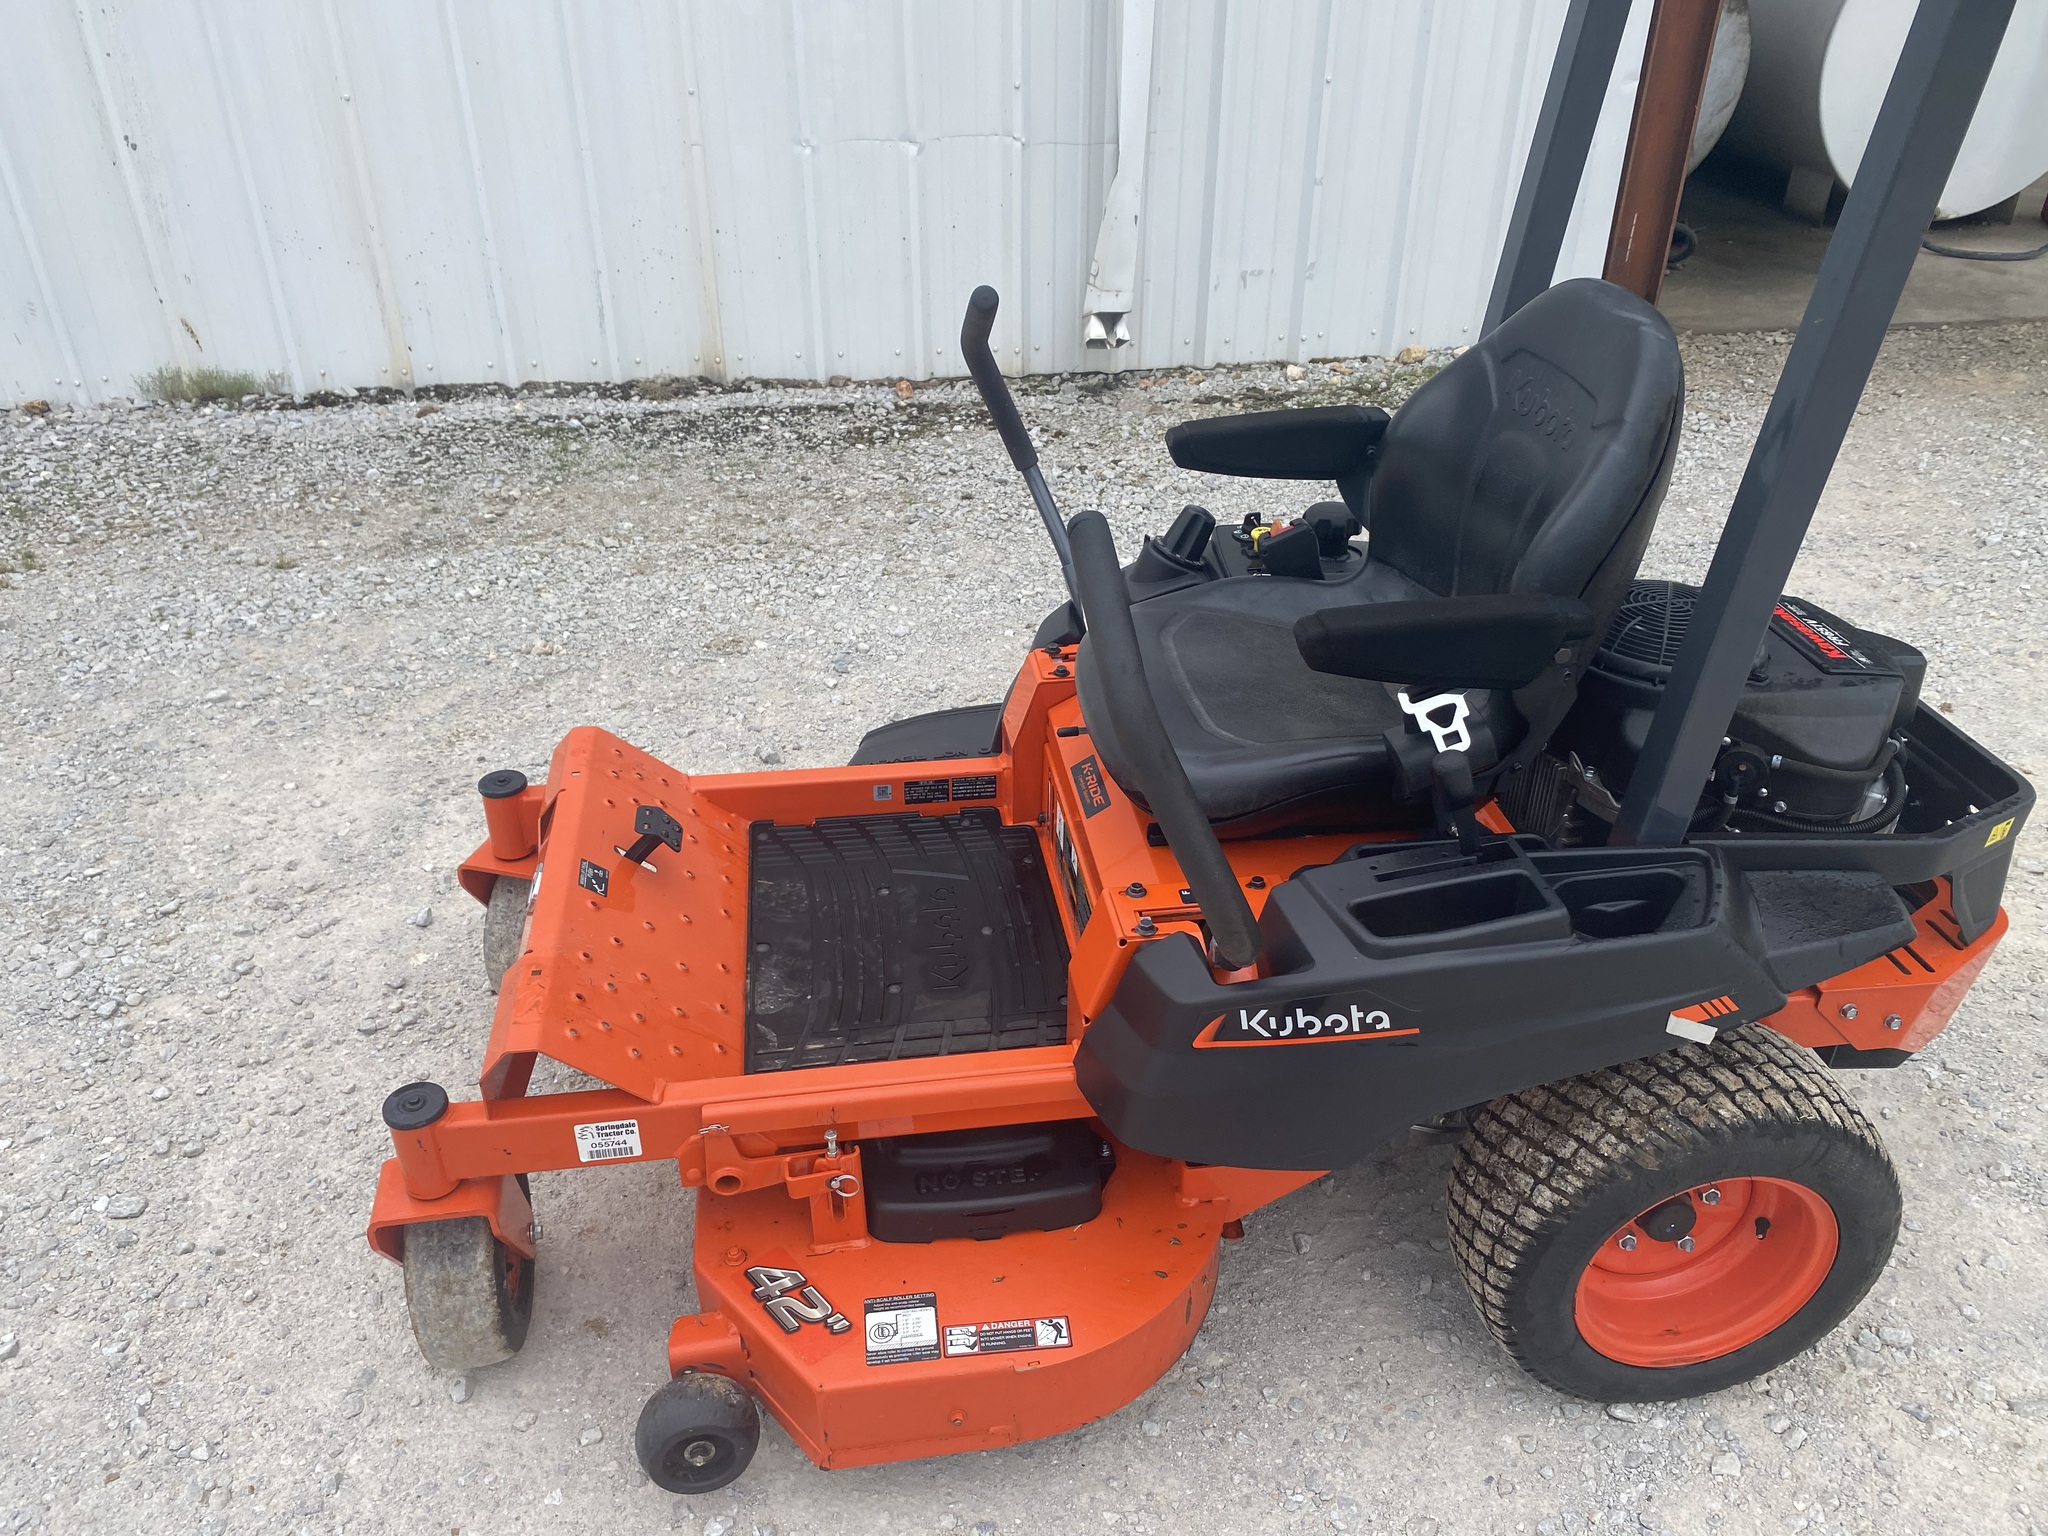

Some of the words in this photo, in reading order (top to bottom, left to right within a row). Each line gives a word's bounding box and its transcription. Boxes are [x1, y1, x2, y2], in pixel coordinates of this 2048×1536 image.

[1503, 369, 1577, 453] Kubota
[1773, 605, 1847, 659] Kawasak
[1081, 762, 1105, 807] K-RIDE
[921, 886, 969, 990] Kubota
[1239, 1004, 1391, 1038] Kubota
[590, 1139, 628, 1149] 055744
[595, 1122, 636, 1132] Springdale
[596, 1130, 624, 1138] Tractor
[991, 1319, 1031, 1330] DANGER
